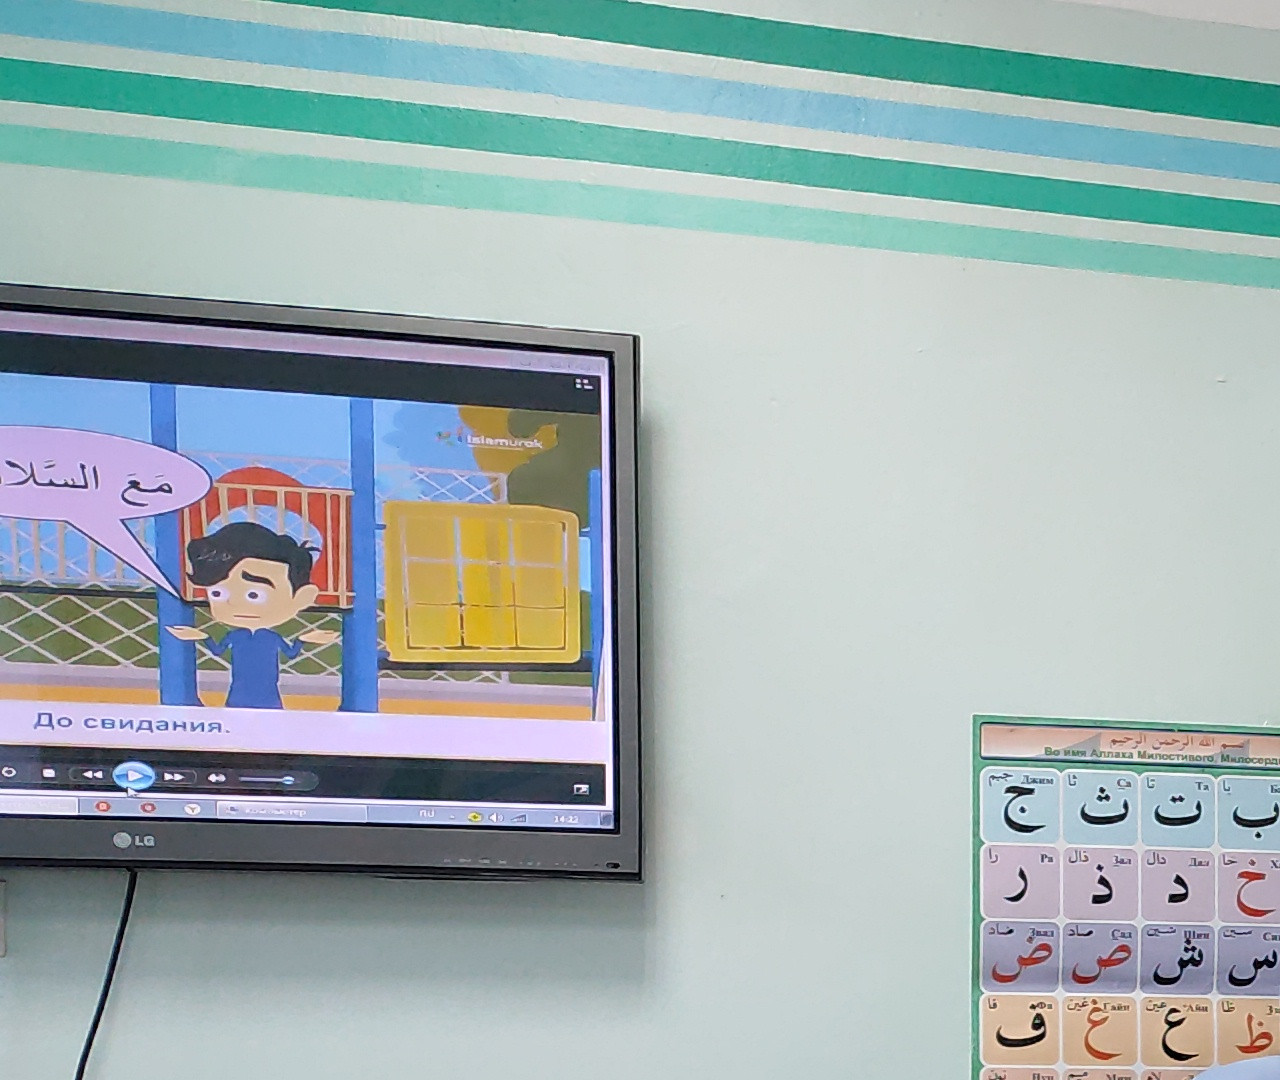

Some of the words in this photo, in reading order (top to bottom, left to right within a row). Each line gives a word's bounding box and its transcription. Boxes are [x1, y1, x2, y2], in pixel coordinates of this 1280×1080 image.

[33, 712, 73, 731] До
[83, 716, 231, 734] свидания.
[1044, 747, 1060, 757] Во
[1064, 749, 1087, 758] имя
[1090, 749, 1133, 759] Аллаха
[1004, 785, 1046, 833] ج
[1080, 787, 1129, 825] ث
[1154, 795, 1202, 826] ت
[1233, 801, 1279, 839] ب
[134, 835, 155, 847] LG
[1003, 866, 1028, 902] ر
[1091, 864, 1113, 904] ذ
[1168, 874, 1189, 903] د
[1237, 859, 1276, 917] خ
[992, 936, 1053, 983] ض
[1072, 944, 1132, 984] ص
[1153, 938, 1204, 985] ش
[1228, 949, 1278, 987] س
[996, 1002, 1047, 1048] ف
[1084, 999, 1122, 1060] غ
[1162, 1008, 1199, 1061] ع
[1235, 1012, 1273, 1054] ظ
